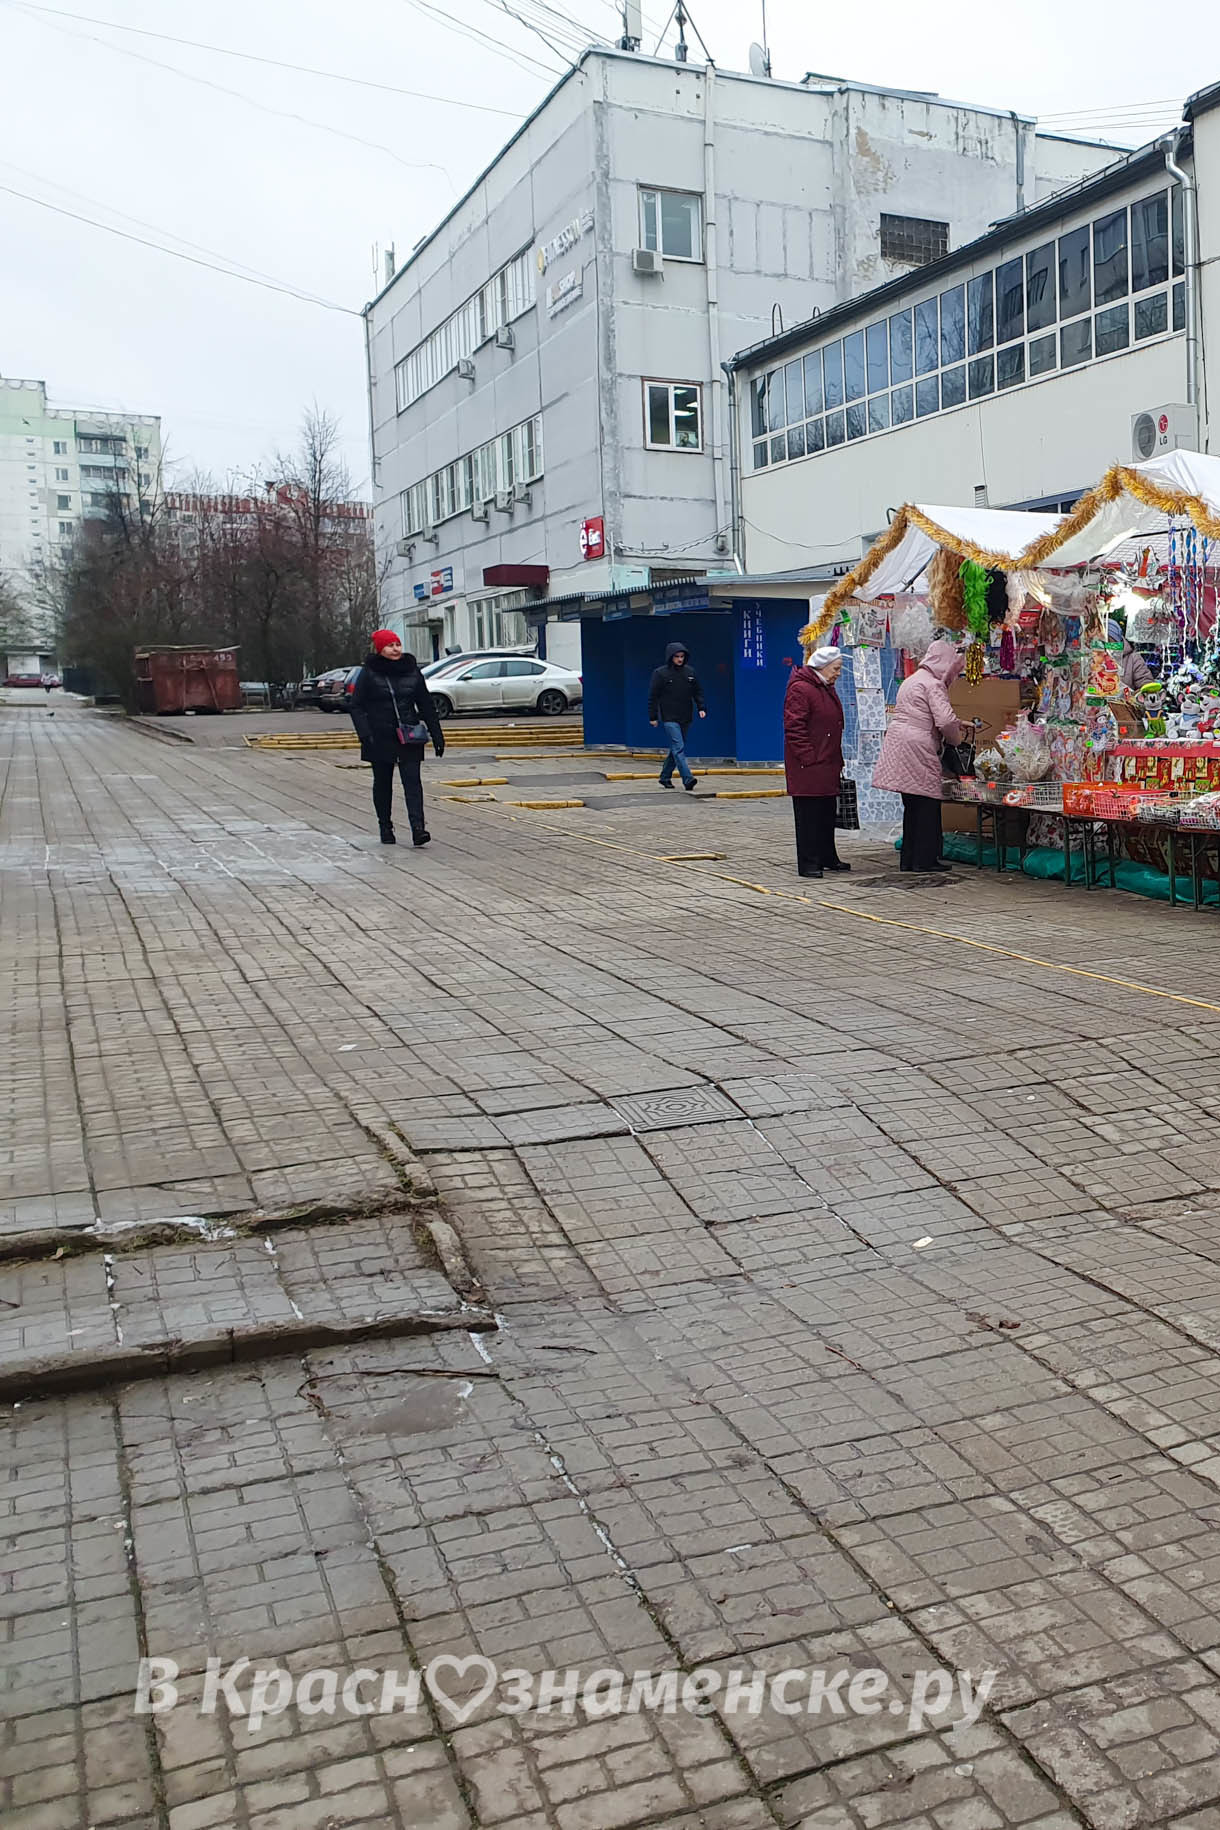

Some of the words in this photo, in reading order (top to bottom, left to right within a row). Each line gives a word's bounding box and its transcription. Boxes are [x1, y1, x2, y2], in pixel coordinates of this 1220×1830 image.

[1159, 435, 1168, 446] LG
[743, 610, 752, 658] КНИГИ
[755, 602, 764, 667] УЧЕБНИКИ
